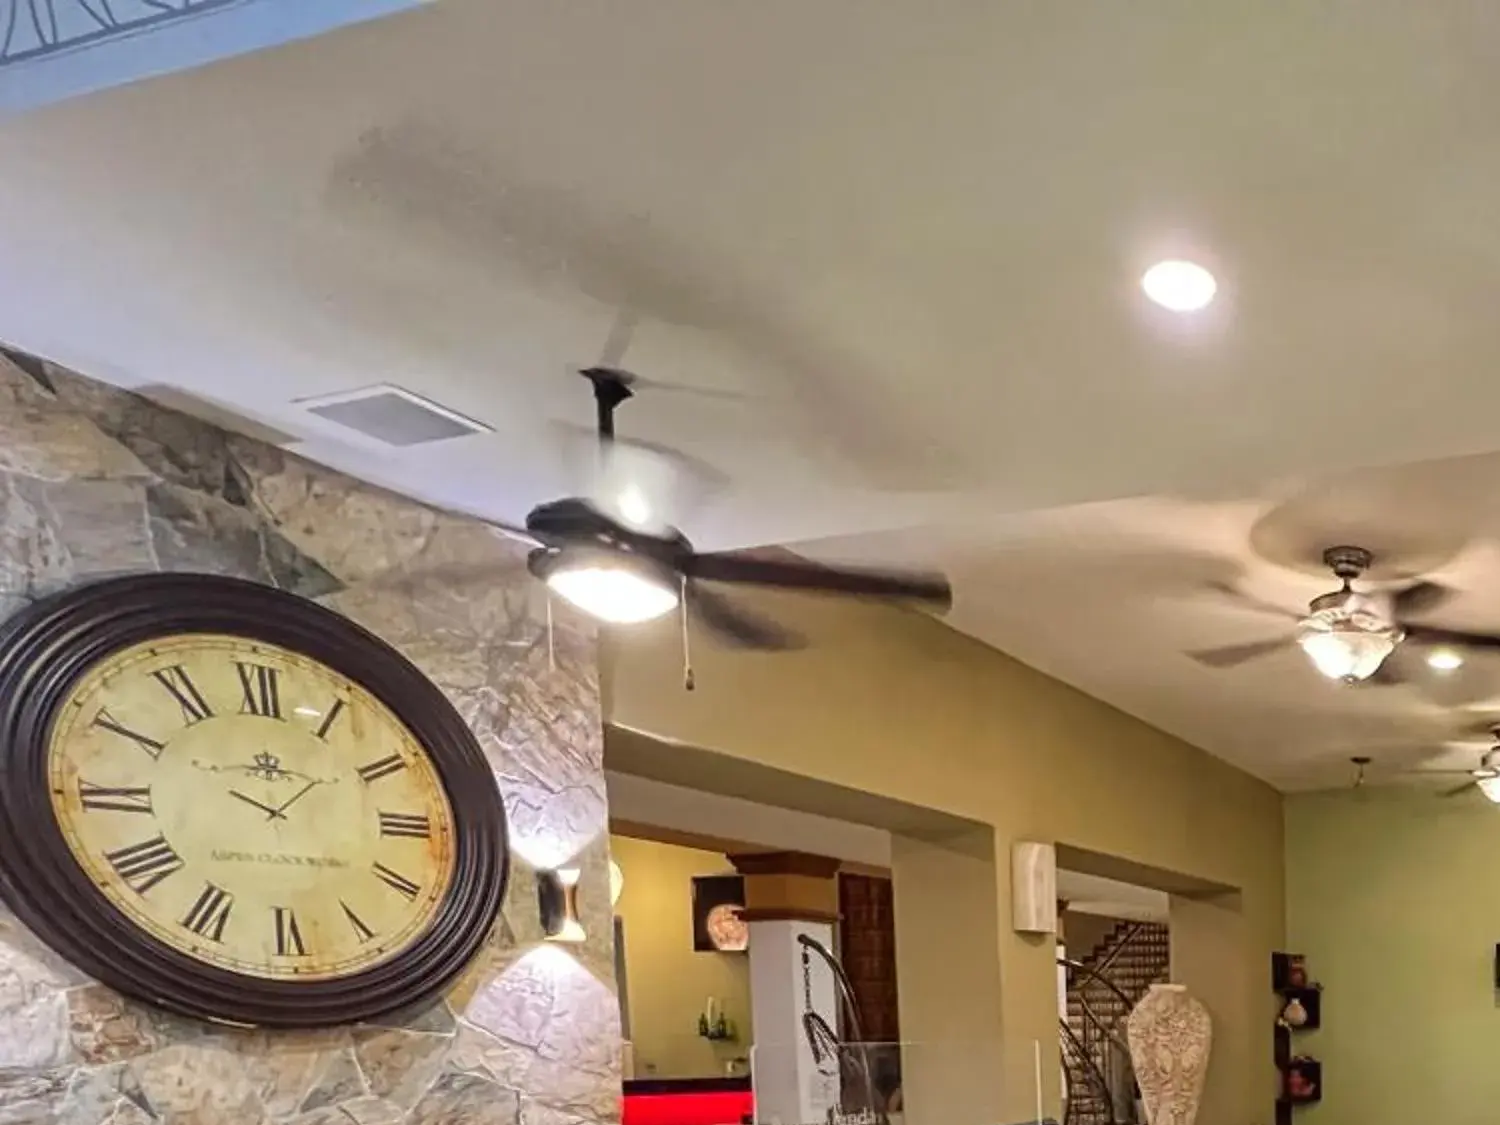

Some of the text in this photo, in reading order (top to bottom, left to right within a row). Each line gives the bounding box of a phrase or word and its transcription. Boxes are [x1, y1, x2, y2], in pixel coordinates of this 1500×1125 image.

[147, 661, 216, 727] XI
[230, 660, 287, 721] XII
[92, 707, 168, 760] X
[377, 808, 431, 838] III
